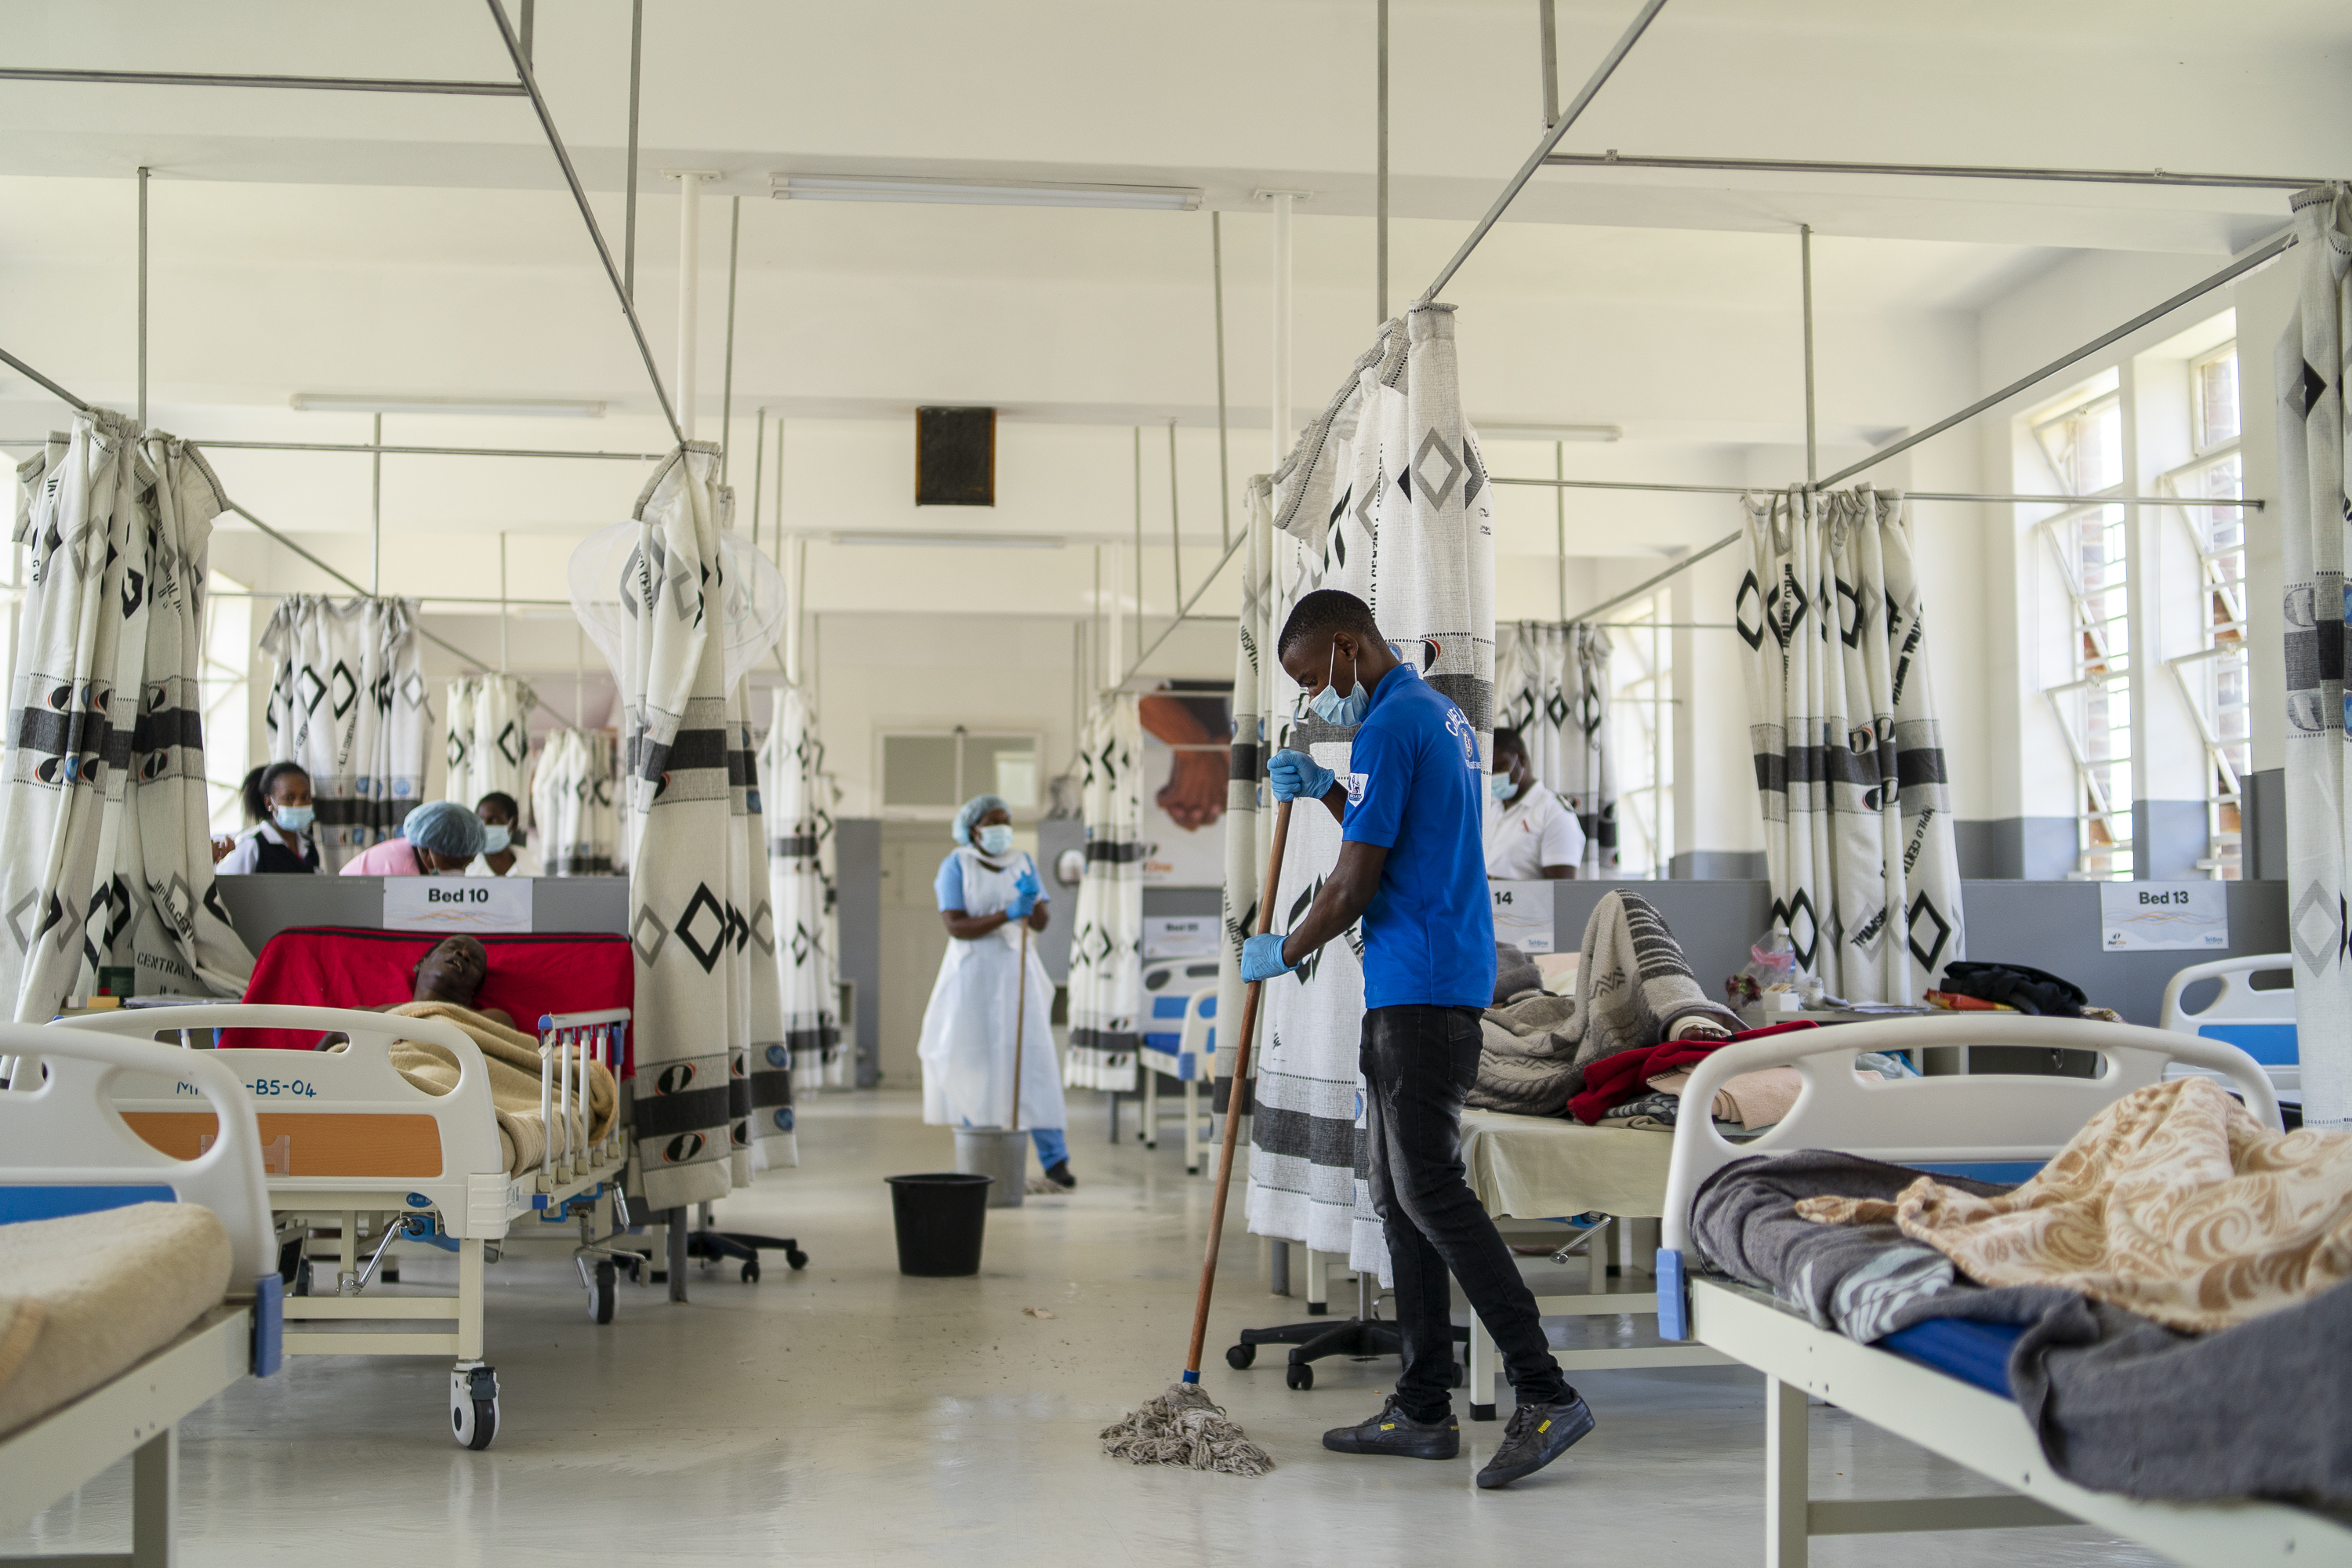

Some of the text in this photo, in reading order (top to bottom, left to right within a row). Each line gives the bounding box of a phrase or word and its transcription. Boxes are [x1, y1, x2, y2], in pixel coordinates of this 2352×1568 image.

[429, 888, 489, 902] Bed 10
[1494, 891, 1513, 905] 14
[2140, 891, 2190, 905] Bed 13
[173, 910, 194, 945] CENT
[136, 951, 187, 979] CENTRAL
[1380, 1423, 1396, 1432] PUMA
[1537, 1419, 1552, 1434] PUMA
